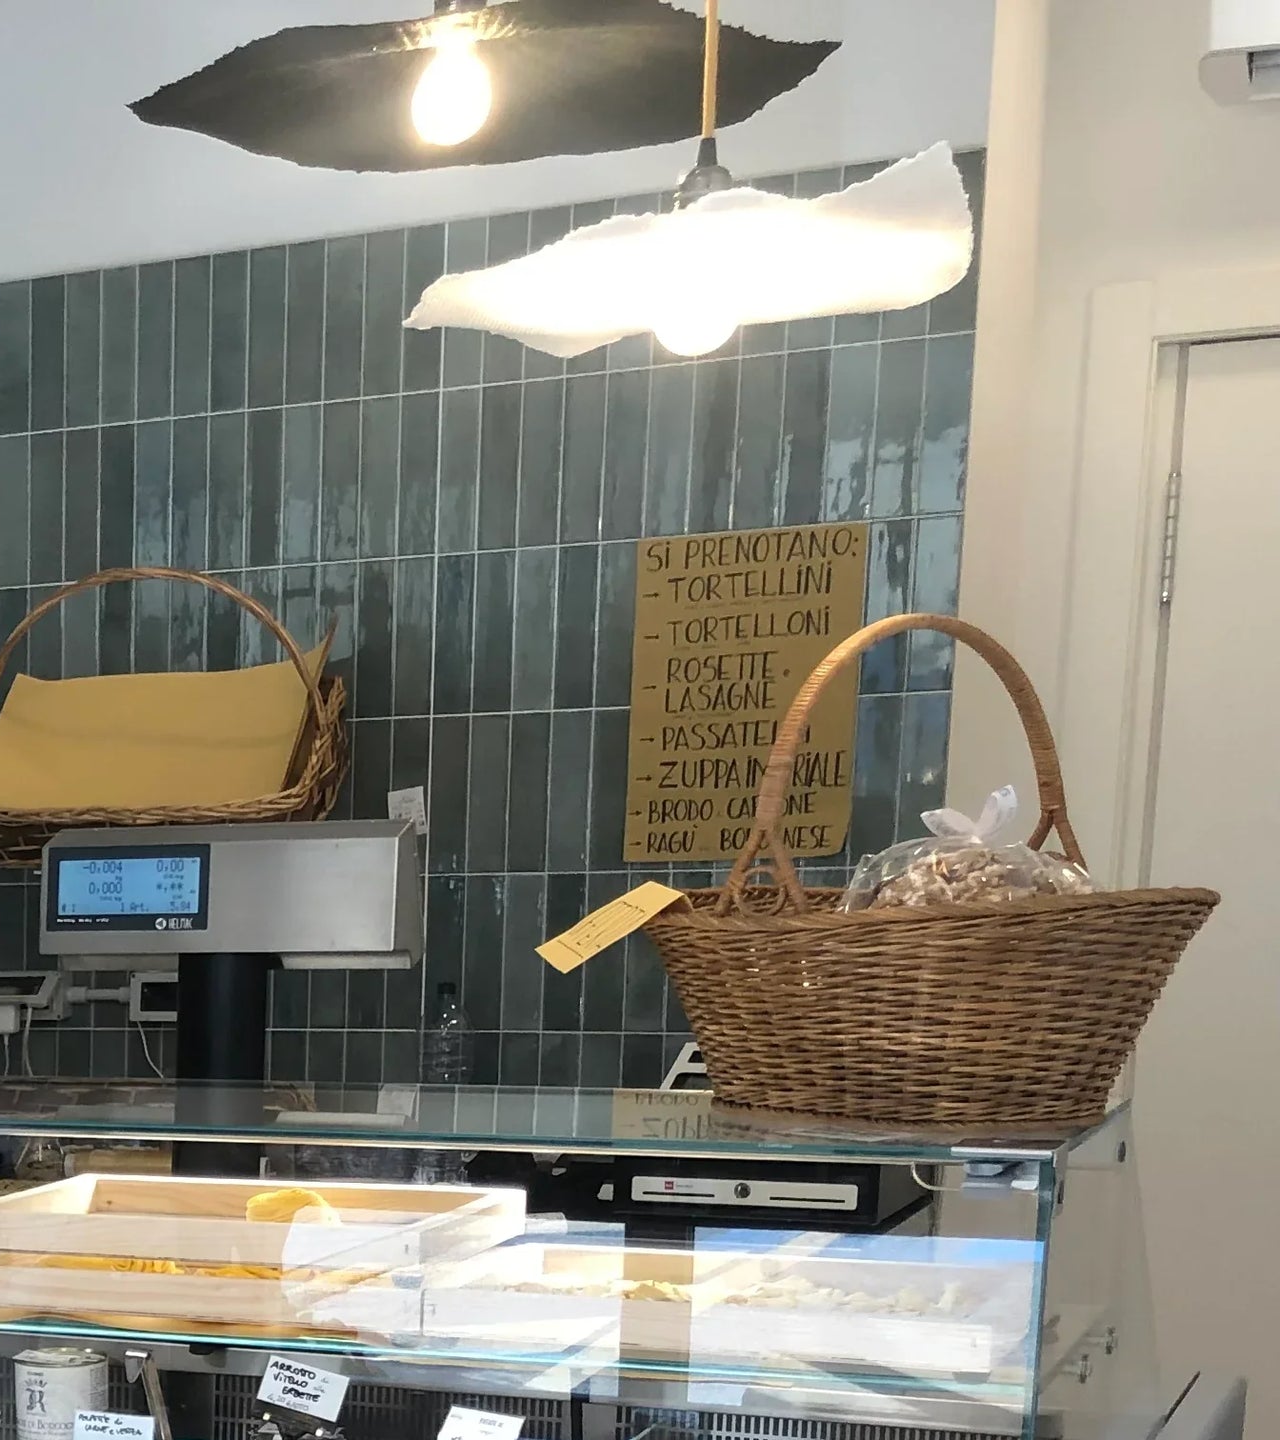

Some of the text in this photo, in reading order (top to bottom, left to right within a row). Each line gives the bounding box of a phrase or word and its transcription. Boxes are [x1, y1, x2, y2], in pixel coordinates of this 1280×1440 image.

[684, 527, 859, 570] PRENOTANO:
[667, 561, 832, 603] TORTELLINI
[667, 606, 830, 645] TORTELLONI
[666, 651, 780, 684] ROSETTE
[664, 680, 776, 713] LASAGNE
[658, 758, 742, 789] ZUPPA
[648, 798, 713, 825] BRODO
